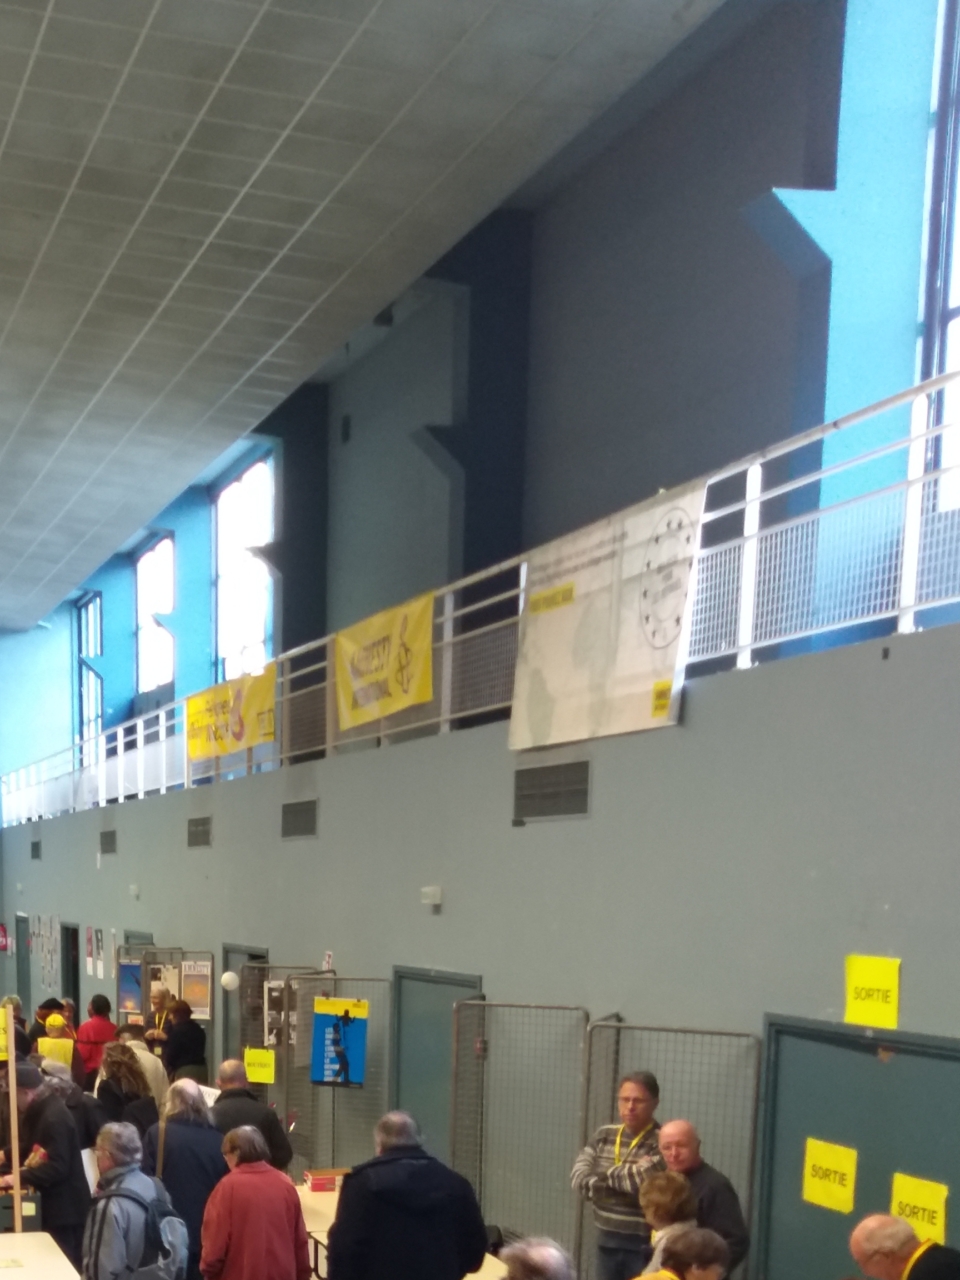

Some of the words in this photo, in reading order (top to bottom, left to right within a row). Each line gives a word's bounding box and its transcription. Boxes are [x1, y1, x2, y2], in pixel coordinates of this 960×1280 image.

[853, 986, 892, 1004] SORTIE
[811, 1163, 848, 1188] SORTIE
[897, 1200, 938, 1226] SORTIE
